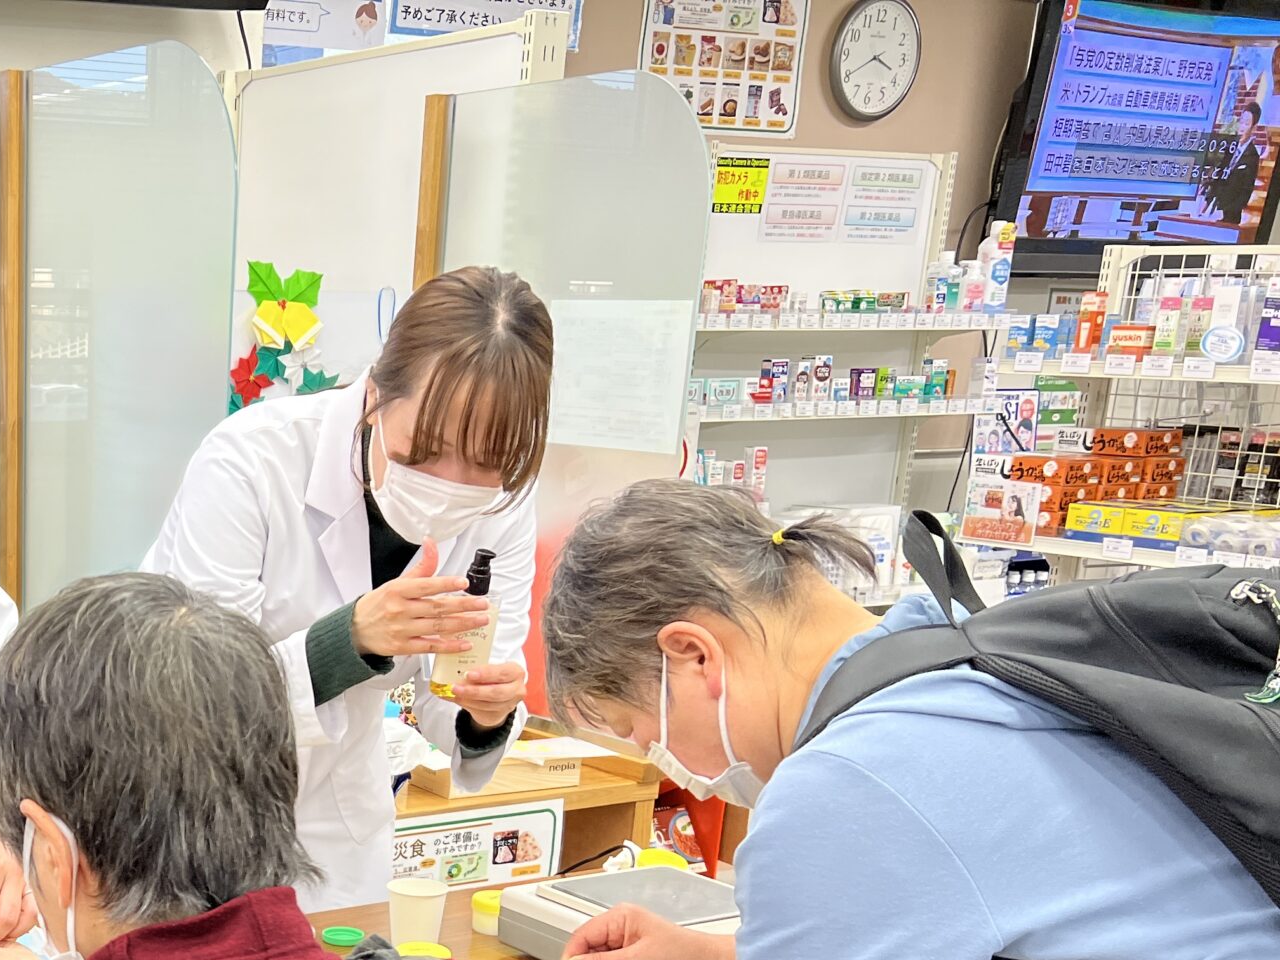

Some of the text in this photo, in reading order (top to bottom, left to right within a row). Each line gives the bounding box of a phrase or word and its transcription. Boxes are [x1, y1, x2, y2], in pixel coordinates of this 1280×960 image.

[863, 14, 873, 28] 11
[876, 8, 887, 22] 12
[893, 16, 898, 31] 1
[850, 28, 861, 42] 10
[898, 33, 906, 46] 2
[843, 48, 850, 62] 9
[899, 53, 906, 67] 3
[843, 69, 851, 83] 8
[890, 72, 897, 87] 4
[853, 84, 861, 99] 7
[863, 90, 871, 105] 6
[878, 86, 886, 102] 5
[1112, 334, 1142, 343] yuskin
[549, 761, 576, 772] nepia
